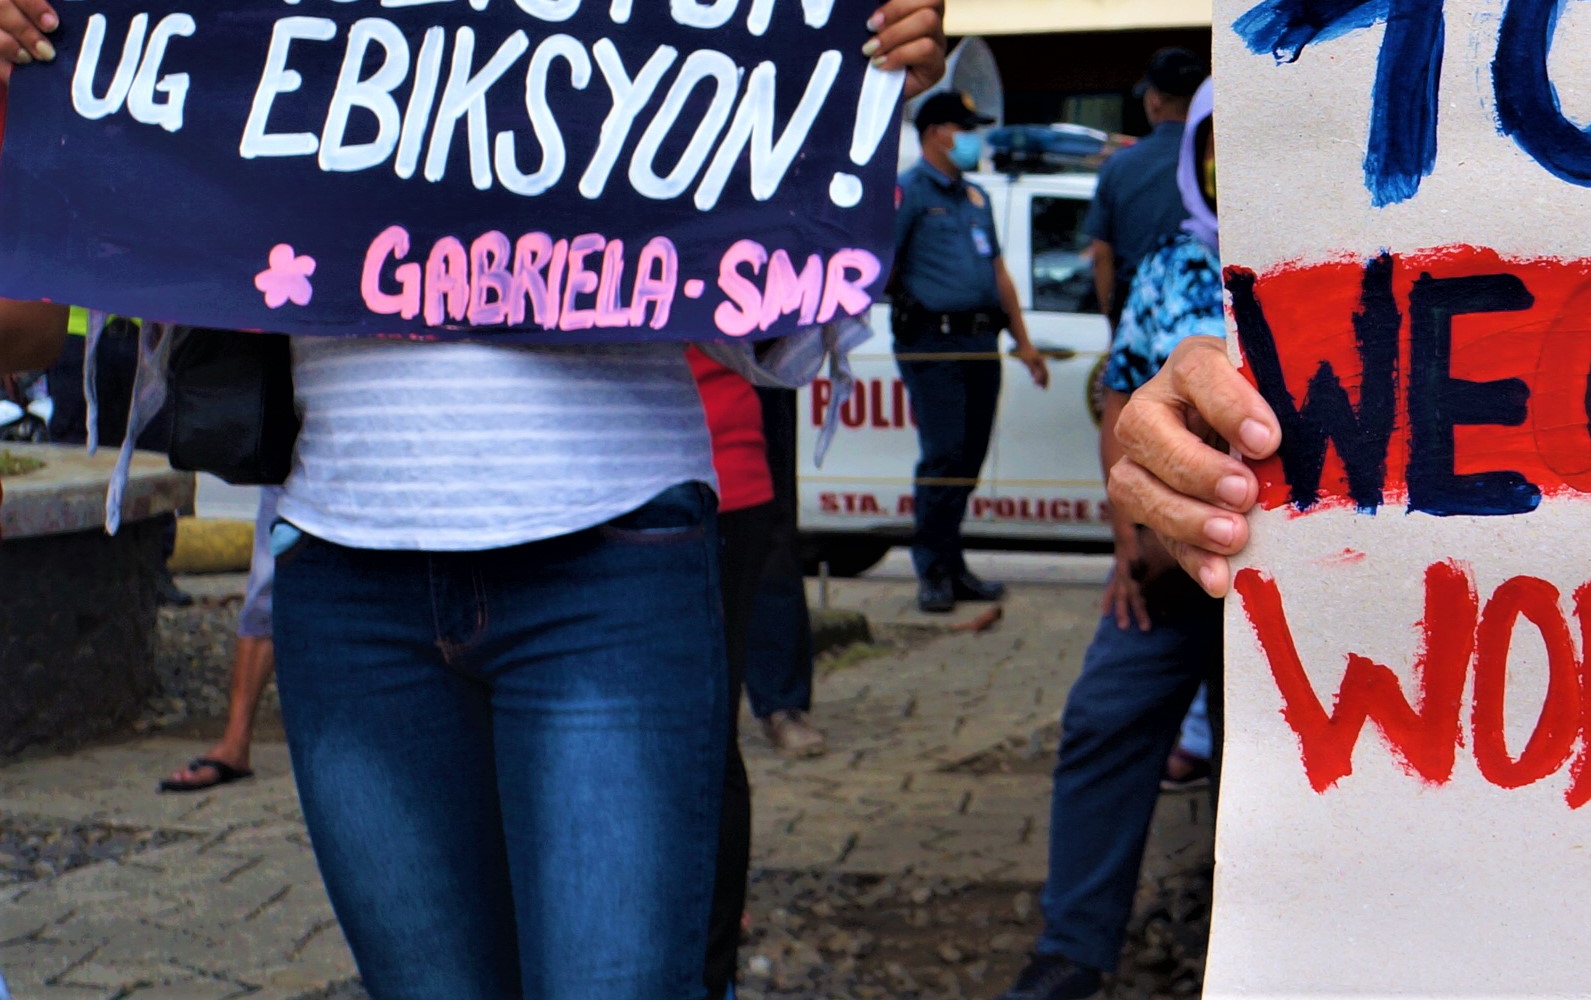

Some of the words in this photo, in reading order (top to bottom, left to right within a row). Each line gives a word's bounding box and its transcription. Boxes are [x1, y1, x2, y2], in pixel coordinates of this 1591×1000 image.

[70, 11, 197, 133] UG
[239, 13, 908, 212] EBIKSYON!
[1222, 245, 1542, 518] WE
